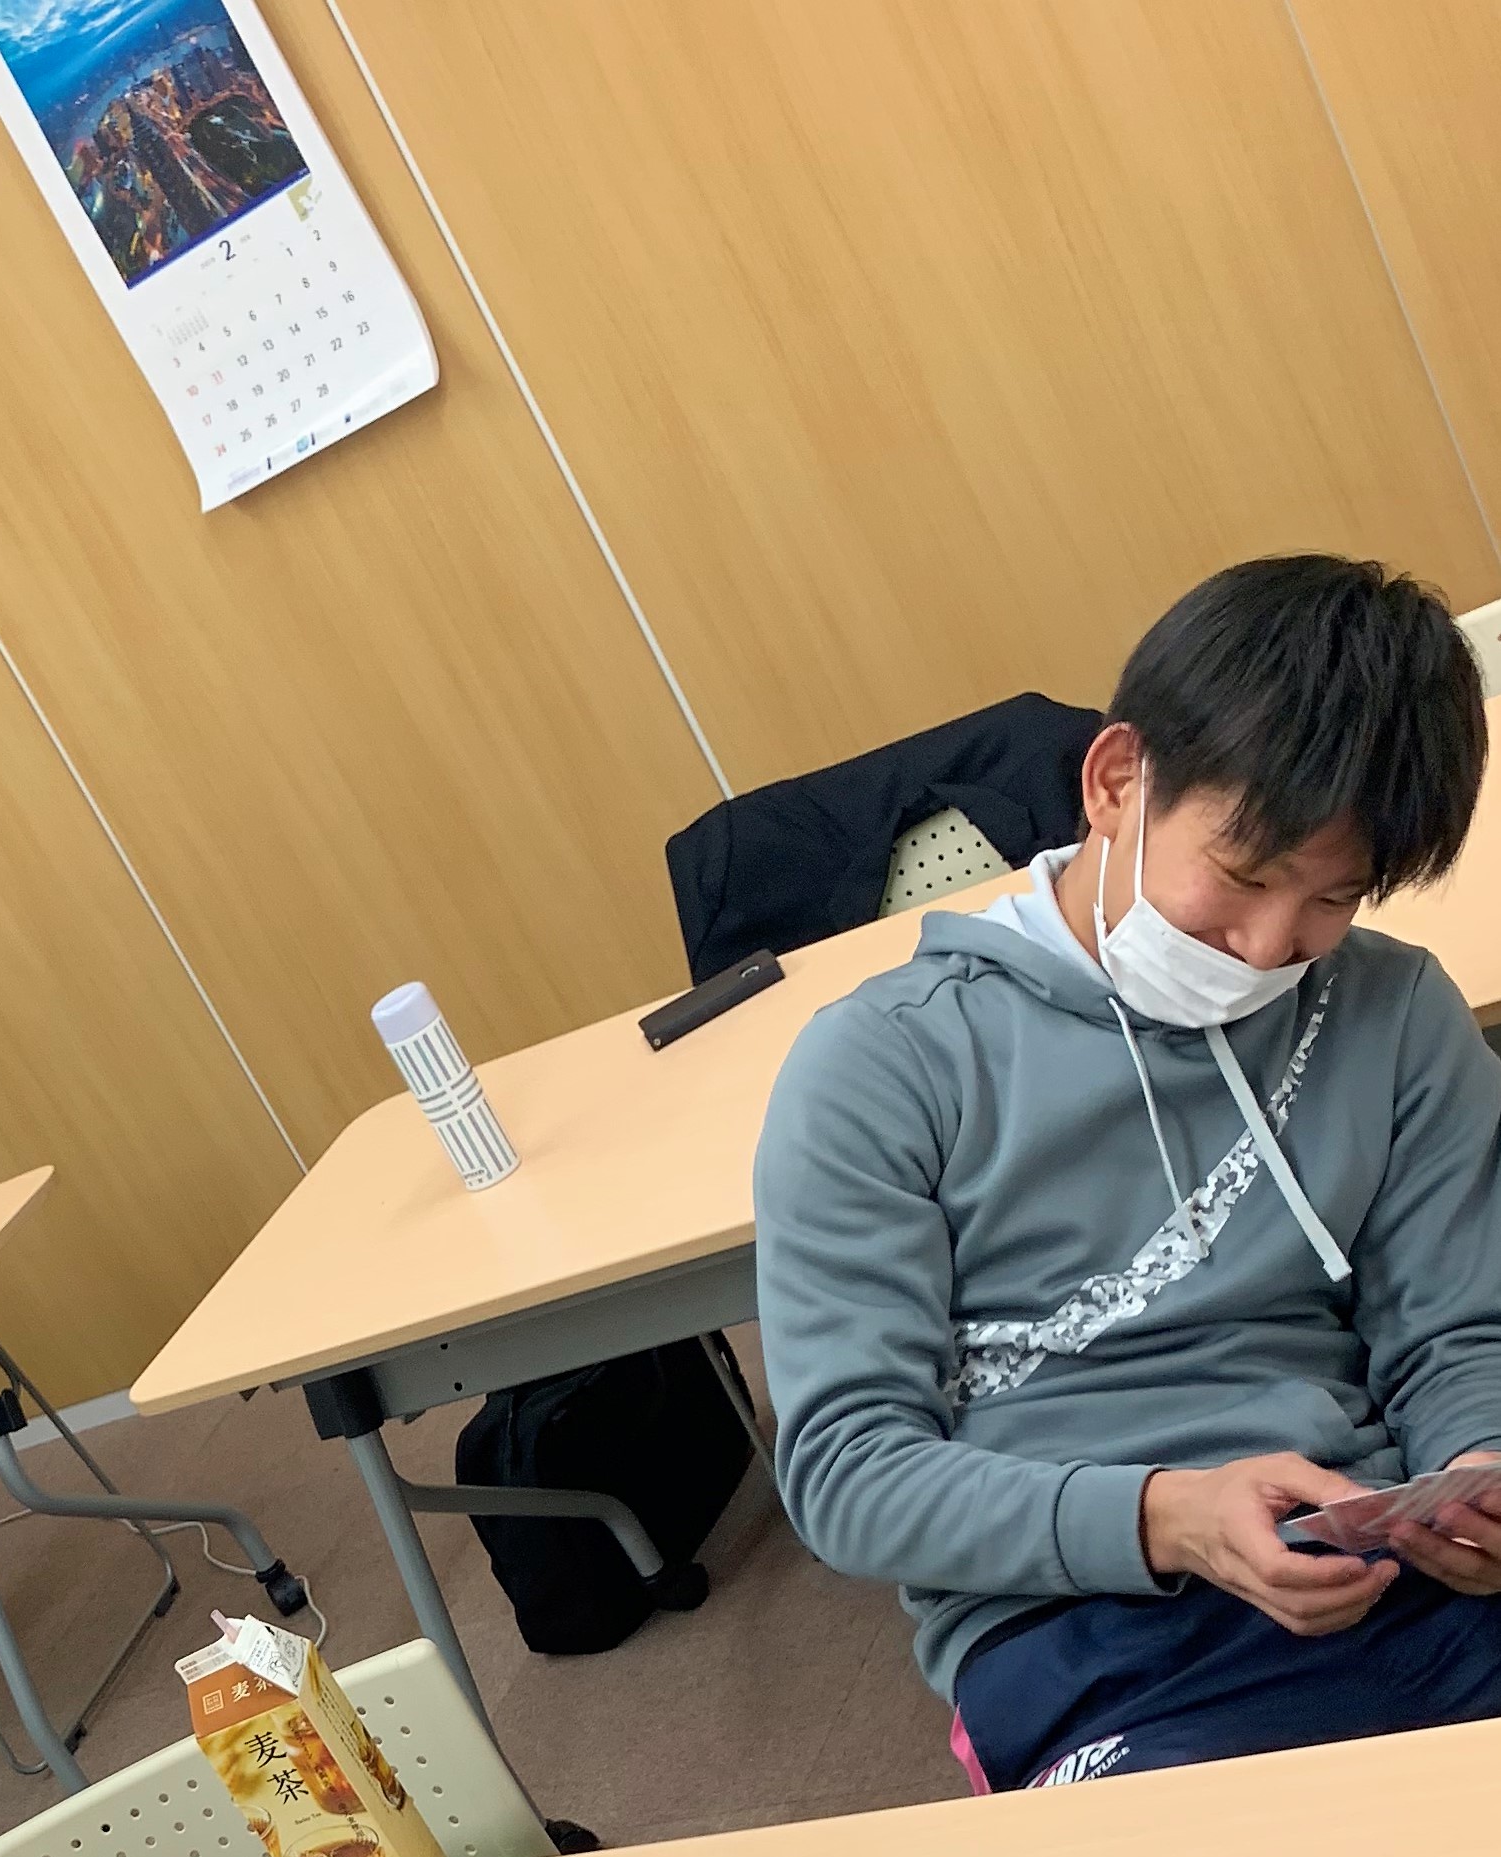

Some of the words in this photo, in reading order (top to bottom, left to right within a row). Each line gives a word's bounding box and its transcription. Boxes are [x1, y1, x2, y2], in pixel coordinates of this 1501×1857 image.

[219, 240, 236, 261] 2
[248, 309, 257, 322] 6
[274, 293, 282, 305] 7
[302, 277, 310, 289] 8
[328, 260, 338, 272] 9
[185, 384, 199, 397] 10
[211, 370, 224, 385] 11
[236, 354, 249, 367] 12
[262, 338, 275, 352] 13
[288, 323, 301, 336] 14
[315, 306, 329, 320] 15
[342, 290, 355, 304] 16
[201, 413, 212, 426] 17
[226, 399, 239, 412] 18
[251, 383, 264, 397] 19
[277, 368, 291, 383] 20
[303, 353, 316, 367] 21
[329, 337, 343, 352] 22
[356, 321, 370, 336] 23
[215, 443, 227, 457] 24
[239, 428, 253, 443] 25
[264, 413, 278, 428] 26
[290, 398, 301, 414] 27
[316, 383, 330, 399] 28
[244, 1731, 309, 1805] 麦茶
